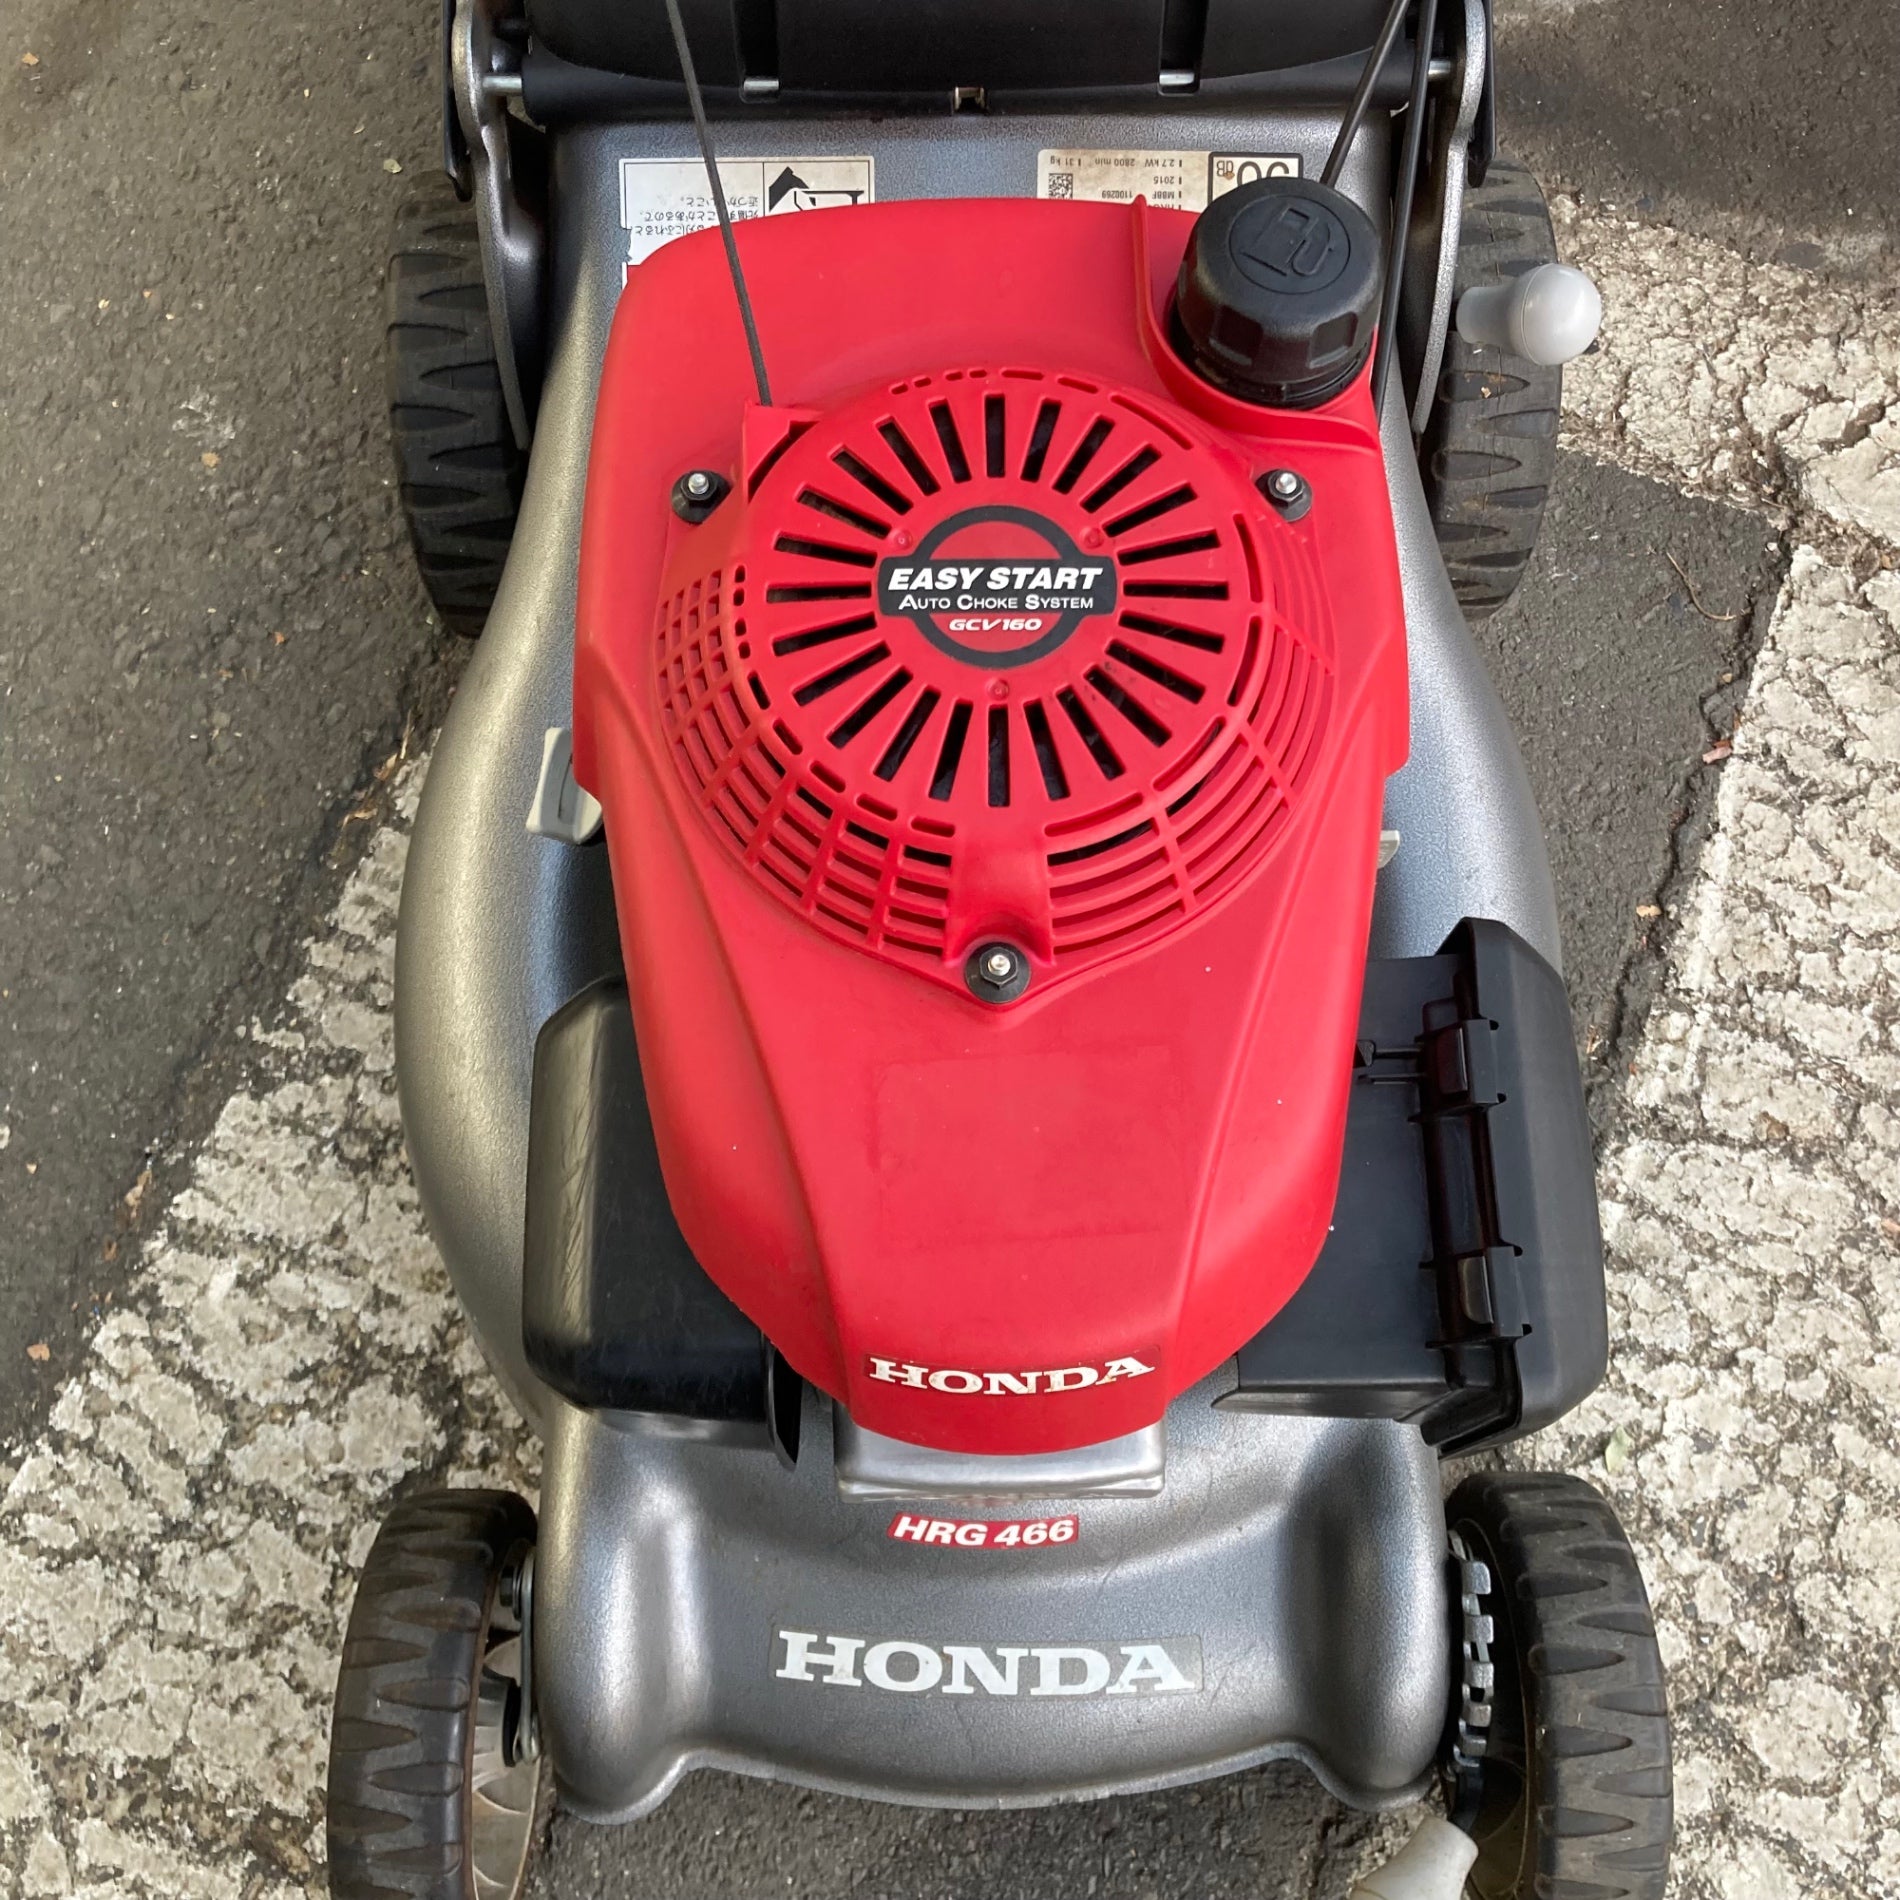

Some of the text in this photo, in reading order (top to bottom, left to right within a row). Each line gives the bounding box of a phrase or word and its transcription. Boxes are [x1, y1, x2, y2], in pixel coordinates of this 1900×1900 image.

[1050, 156, 1075, 166] 31 kg
[1114, 159, 1135, 167] 2800
[1144, 159, 1175, 167] 2.7 kW
[1153, 176, 1175, 184] 2015
[888, 567, 1103, 591] EASY START
[949, 618, 1042, 631] GCV160
[869, 1356, 1155, 1395] HONDA
[894, 1516, 1074, 1546] HRG 466
[775, 1630, 1195, 1695] HONDA
